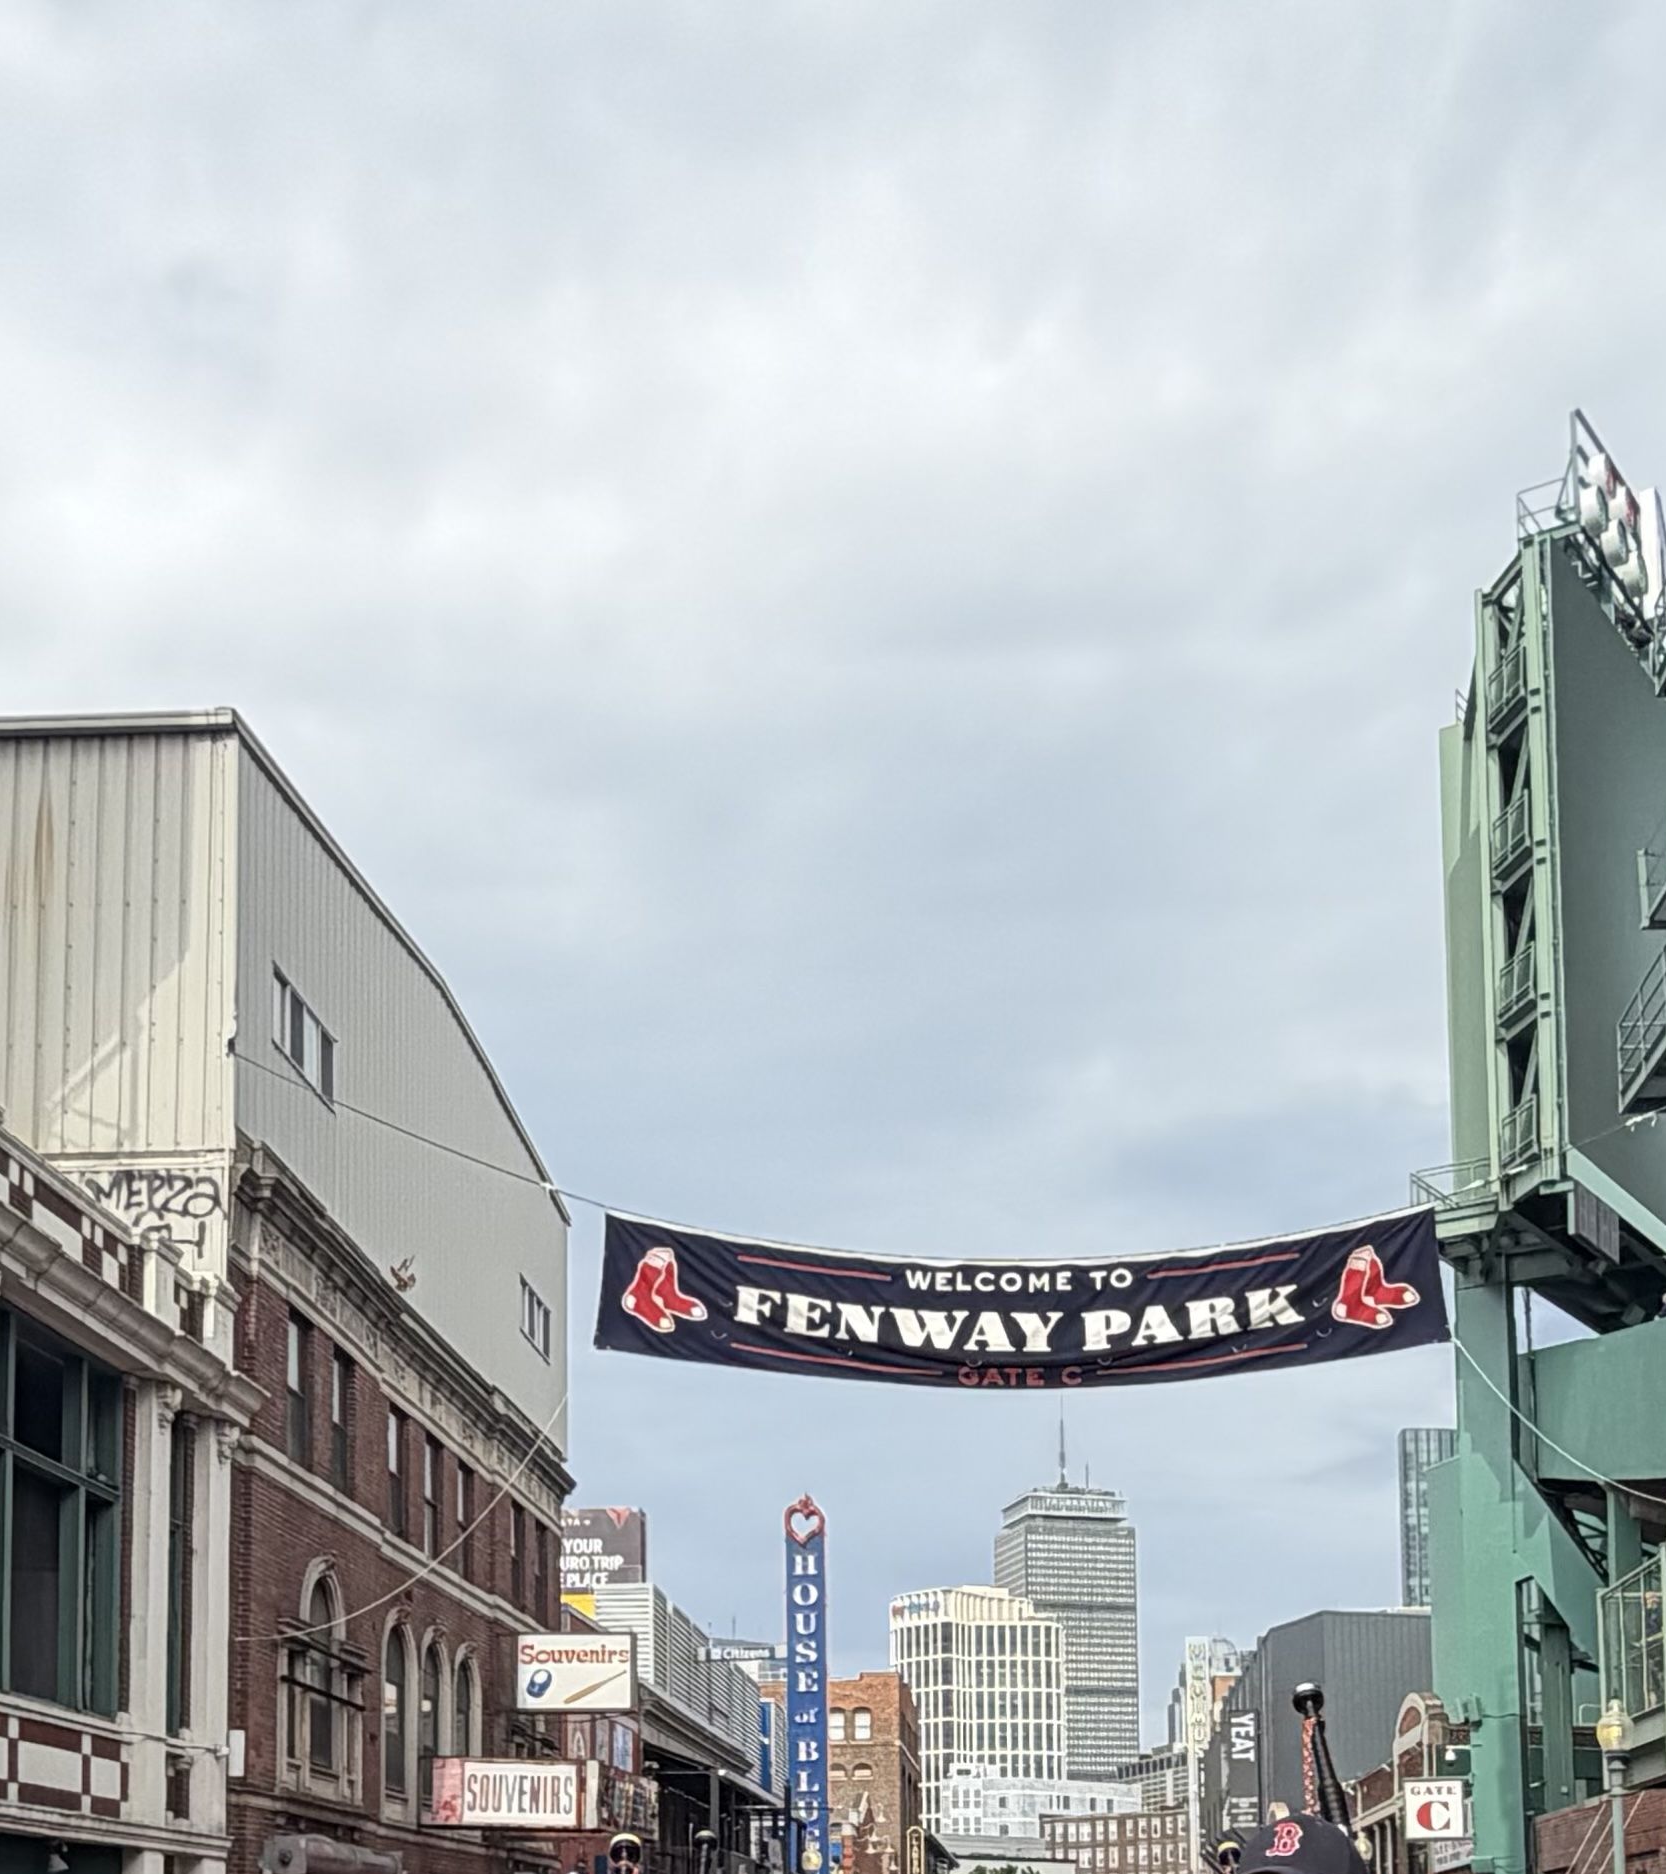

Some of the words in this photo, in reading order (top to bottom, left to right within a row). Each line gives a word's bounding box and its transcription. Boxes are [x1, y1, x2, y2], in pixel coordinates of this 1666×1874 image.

[905, 1268, 1073, 1293] WELCOME
[1089, 1267, 1133, 1290] TO
[733, 1284, 1064, 1352] FENWAY
[1080, 1284, 1306, 1351] PARK
[957, 1365, 1045, 1388] GATE
[1061, 1365, 1083, 1386] C
[562, 1538, 604, 1554] YOUR
[592, 1554, 624, 1571] TRIP
[566, 1572, 609, 1588] PLACE
[792, 1553, 819, 1693] HOUSE
[519, 1643, 630, 1666] Souvenirs
[794, 1707, 819, 1724] of
[1230, 1712, 1255, 1762] YEAT
[466, 1773, 573, 1816] SOUVENIRS
[1410, 1785, 1457, 1796] GATE
[1416, 1800, 1451, 1832] C
[1265, 1821, 1304, 1857] B
